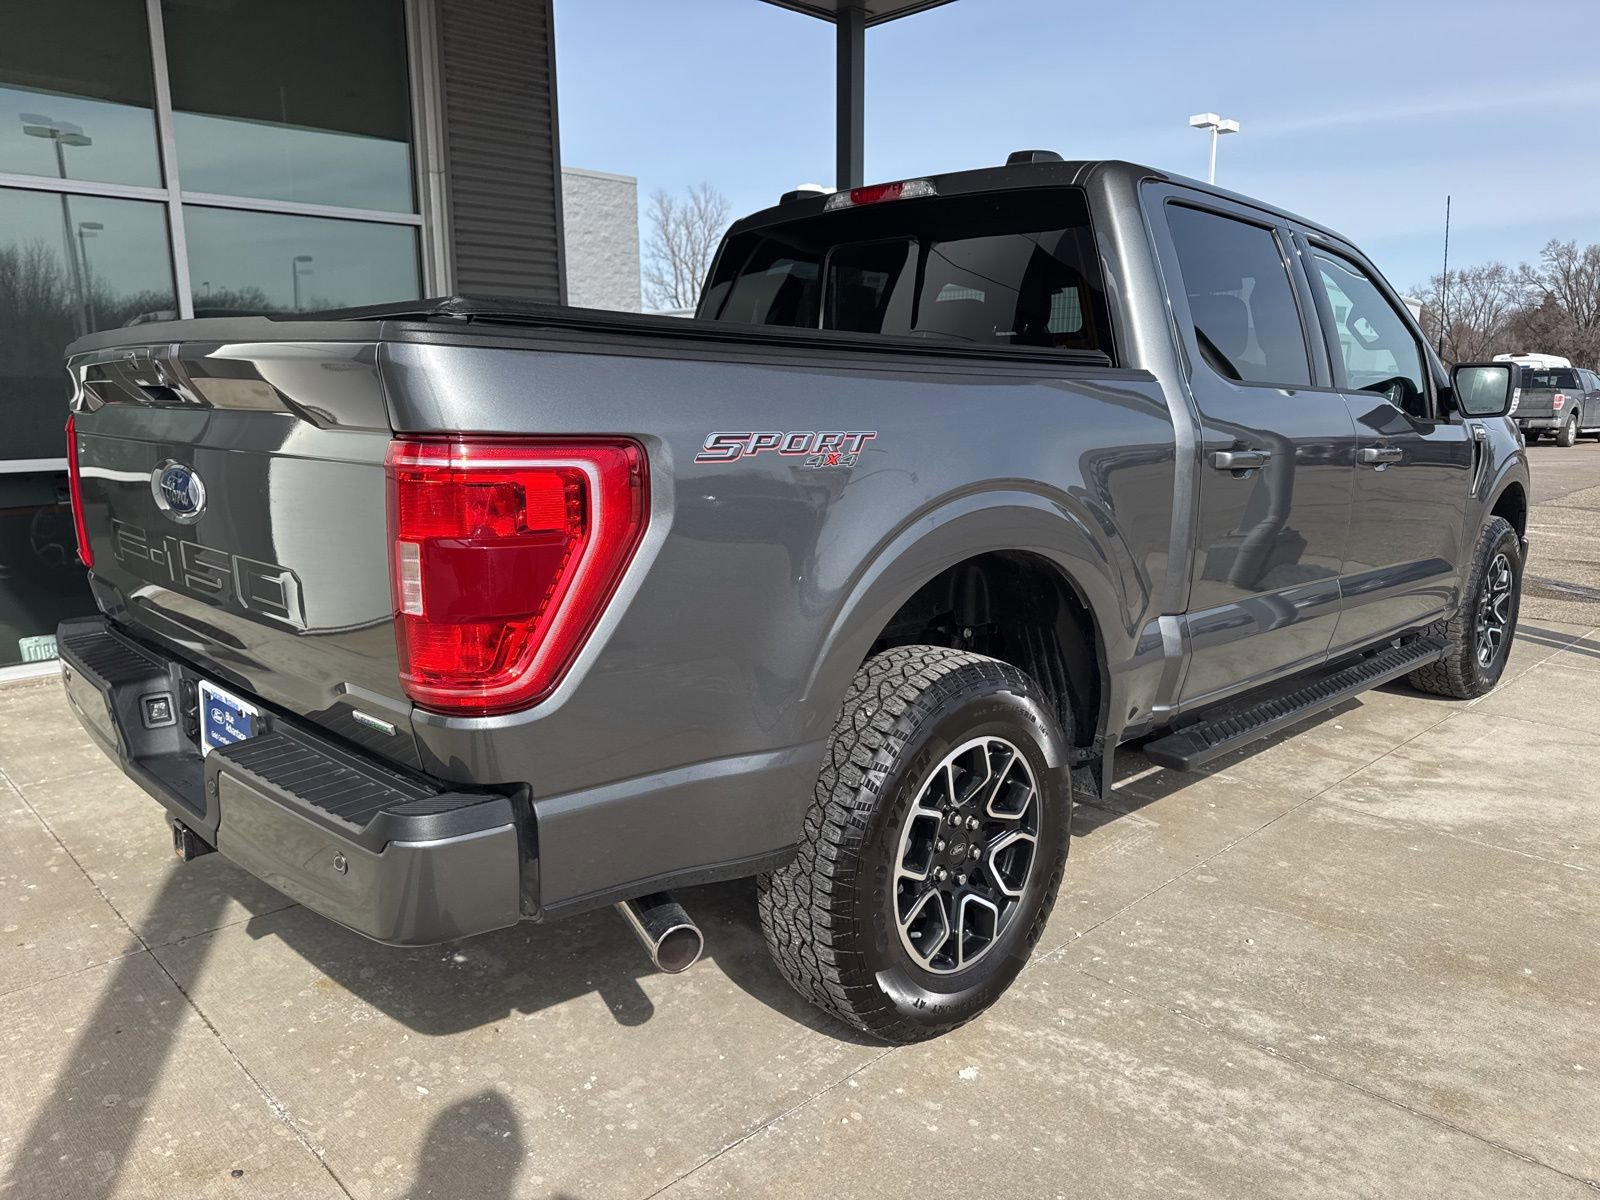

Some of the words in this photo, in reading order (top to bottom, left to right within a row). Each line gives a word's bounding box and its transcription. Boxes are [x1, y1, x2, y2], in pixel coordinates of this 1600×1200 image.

[694, 431, 877, 463] SPORT
[161, 474, 189, 506] Ford
[112, 518, 307, 635] F-150
[950, 842, 966, 856] Ford
